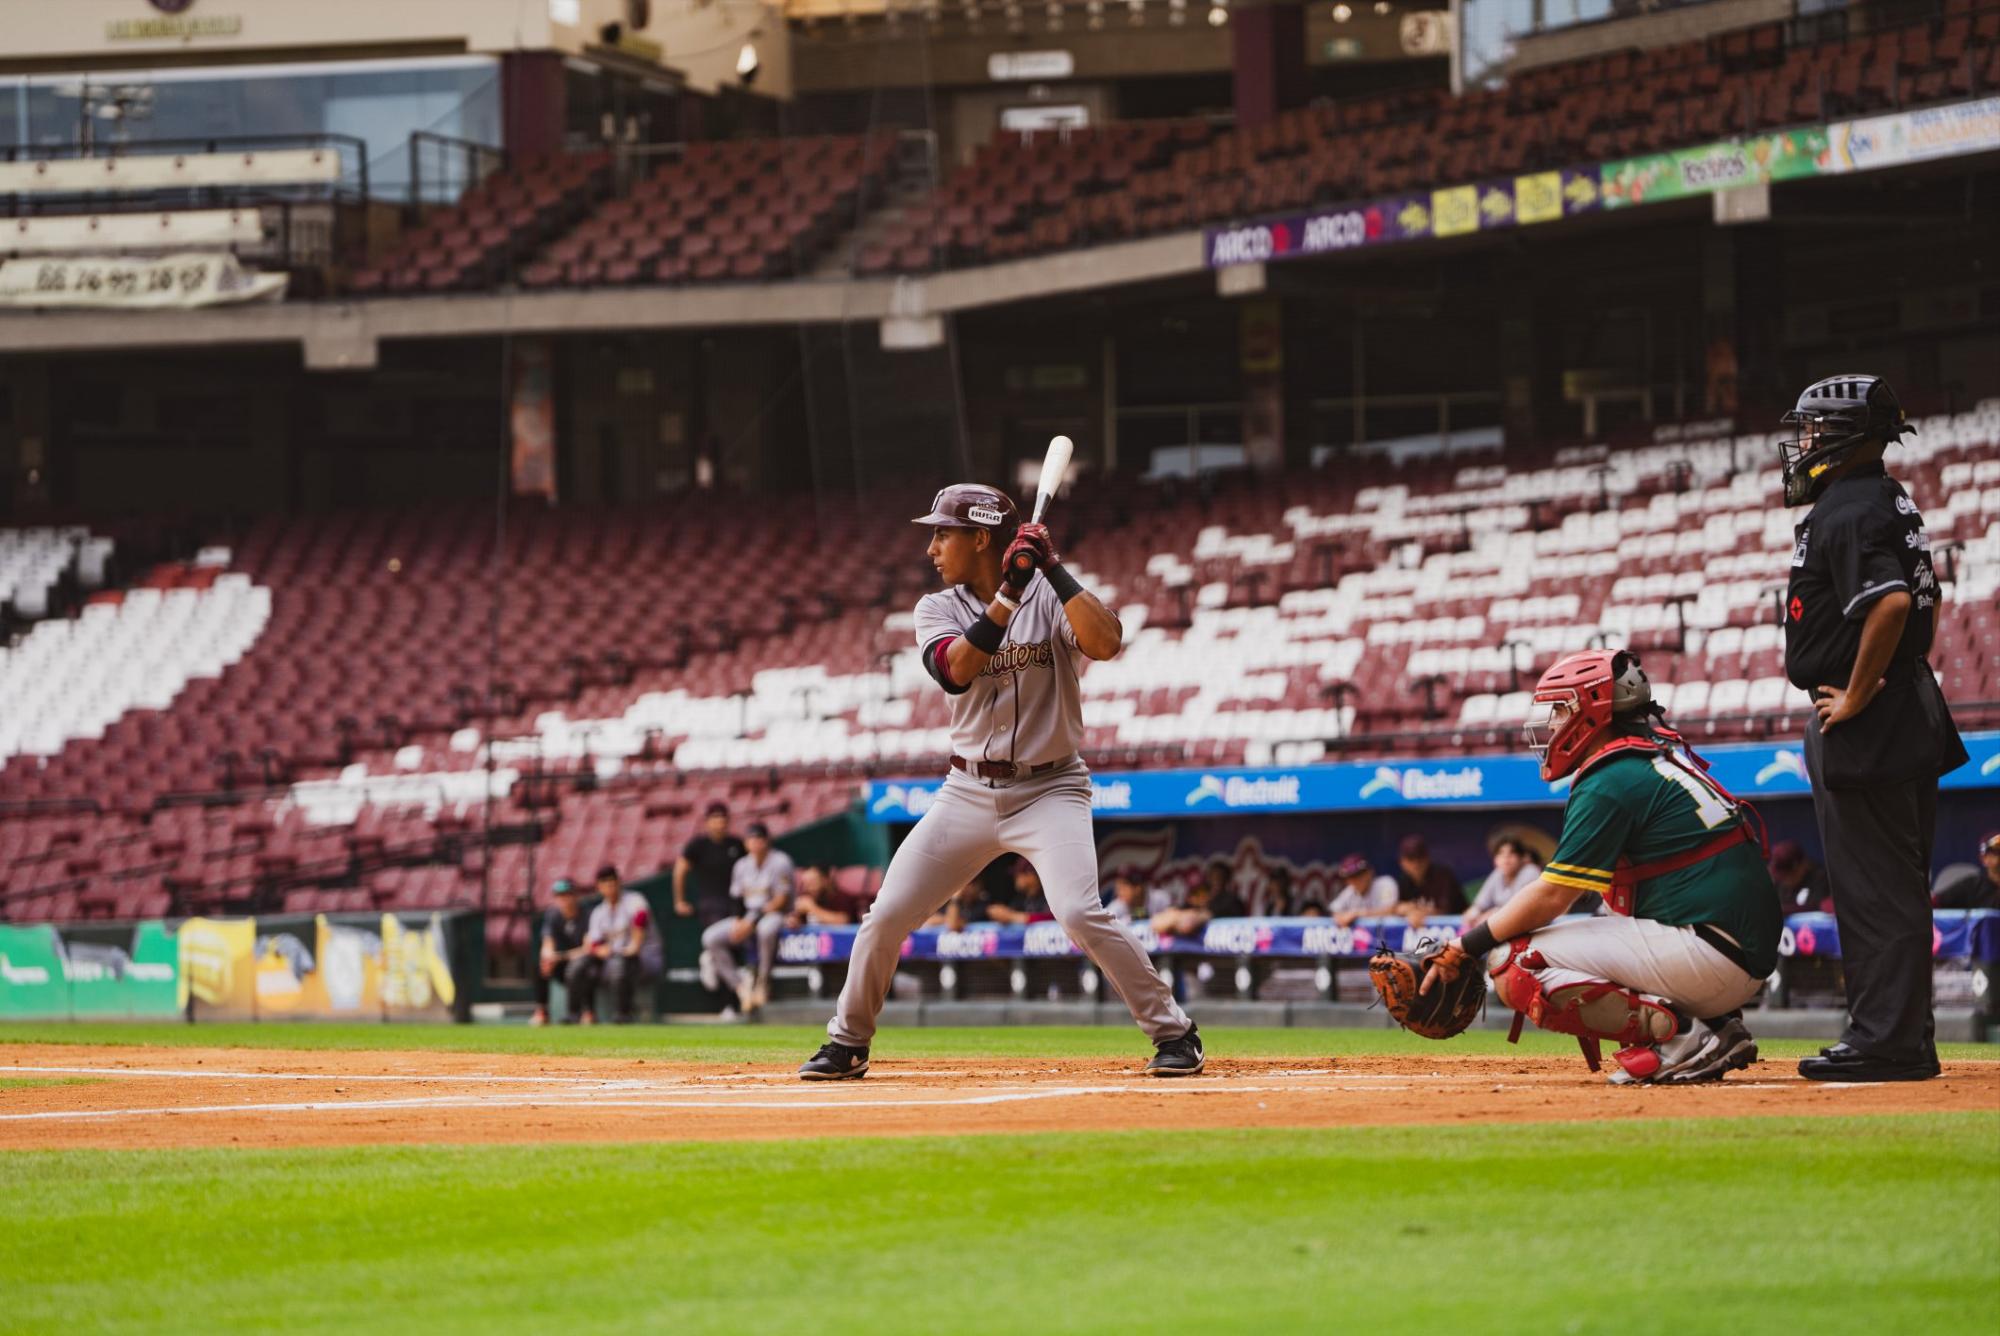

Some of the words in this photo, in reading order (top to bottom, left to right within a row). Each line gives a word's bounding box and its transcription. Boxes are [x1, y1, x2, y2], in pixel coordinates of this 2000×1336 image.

[1213, 226, 1273, 264] ARCO
[1303, 211, 1365, 250] ARCO
[937, 932, 983, 957] ARCO
[1023, 926, 1071, 955] ARCO
[1203, 923, 1256, 953] ARCO
[1302, 925, 1354, 954] ARCO
